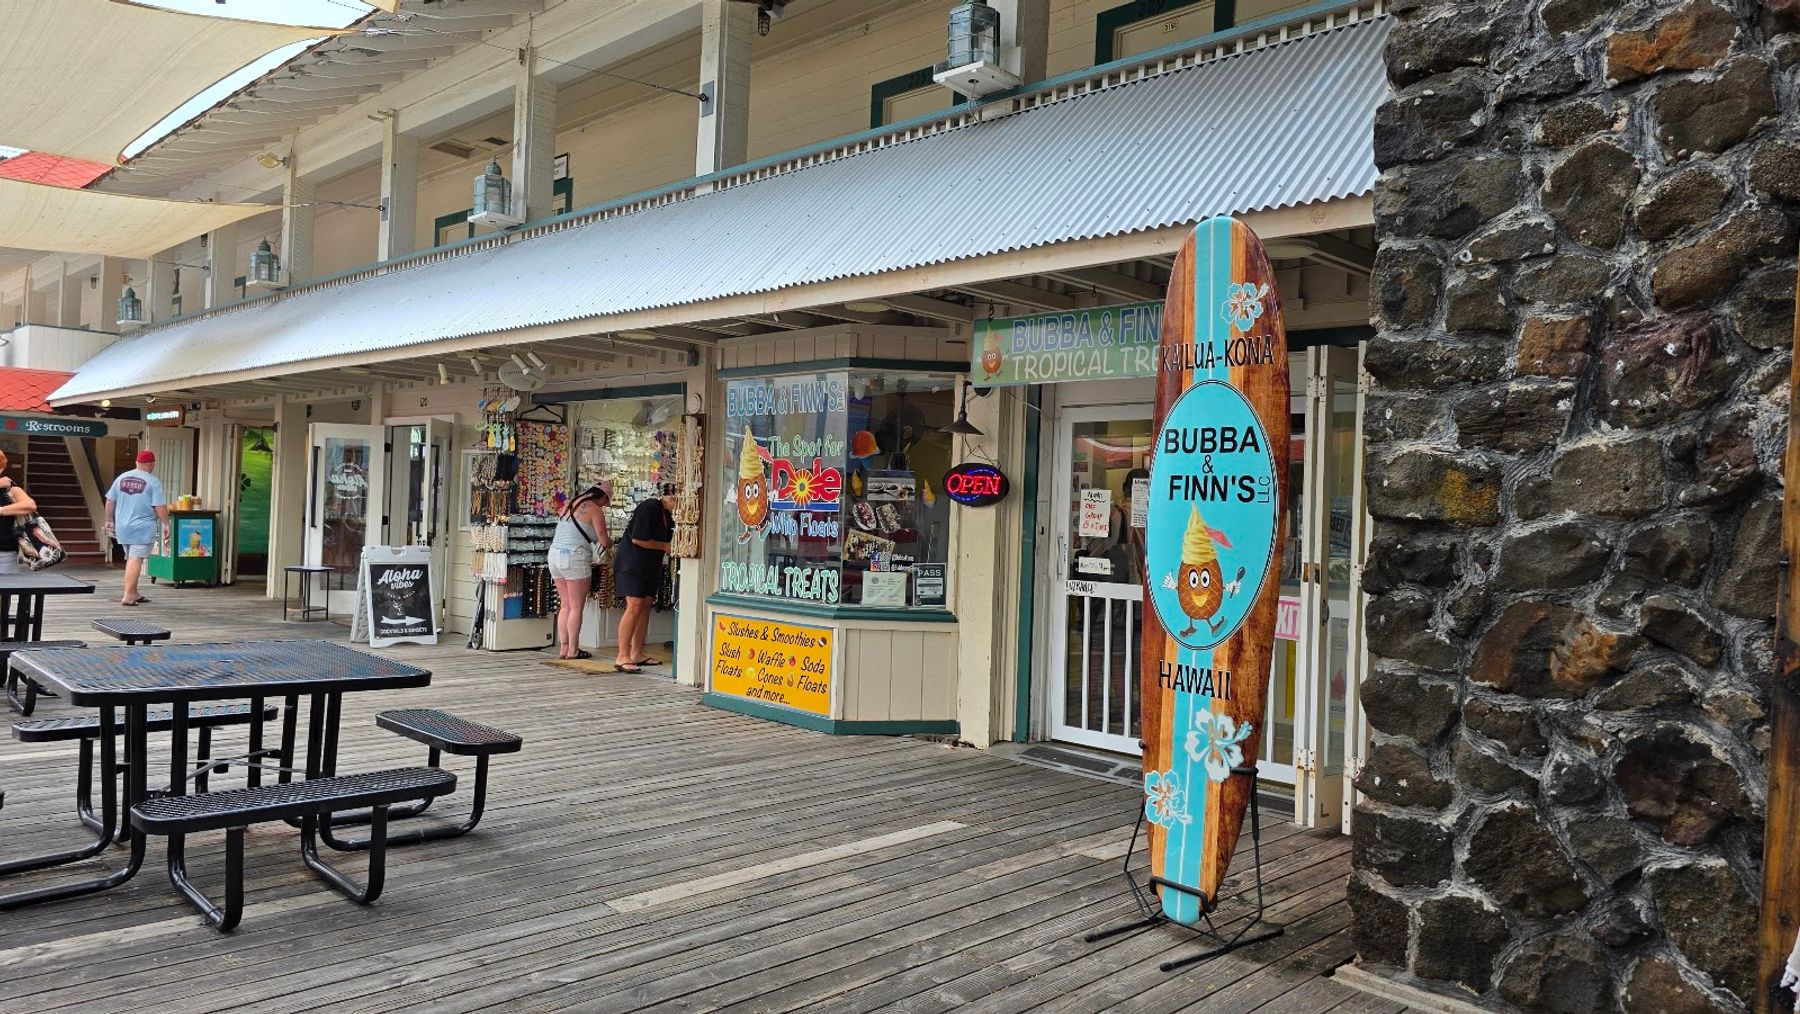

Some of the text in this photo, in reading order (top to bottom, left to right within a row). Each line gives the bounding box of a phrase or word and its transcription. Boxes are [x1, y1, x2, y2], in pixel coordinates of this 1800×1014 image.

[1012, 303, 1165, 355] BUBBA & FIN
[1012, 349, 1114, 381] TROPICAL
[1162, 334, 1275, 372] KAILUA-KONA
[727, 380, 839, 418] BUBBA & FINN'S
[768, 433, 844, 464] The Spot for
[1164, 426, 1260, 454] BUBBA
[1202, 454, 1214, 474] &
[771, 457, 842, 502] Dole
[947, 473, 1001, 495] OPEN
[1169, 475, 1256, 503] FINN'S
[1258, 475, 1271, 504] LLC
[770, 511, 839, 544] Whip Floats
[377, 567, 424, 586] Aloha
[390, 579, 415, 590] vibes
[721, 561, 782, 596] TROPICAL
[784, 566, 839, 602] TREATS
[917, 569, 941, 577] PASS
[1276, 604, 1300, 637] XIT
[728, 621, 816, 649] Slushes & Smoothies
[719, 642, 741, 660] Slush
[757, 650, 786, 668] Waffle
[715, 659, 743, 678] Floats
[757, 668, 784, 686] Cones
[800, 656, 826, 675] Soda
[746, 685, 765, 699] and
[797, 675, 828, 695] Floats
[1158, 660, 1232, 701] HAWAII
